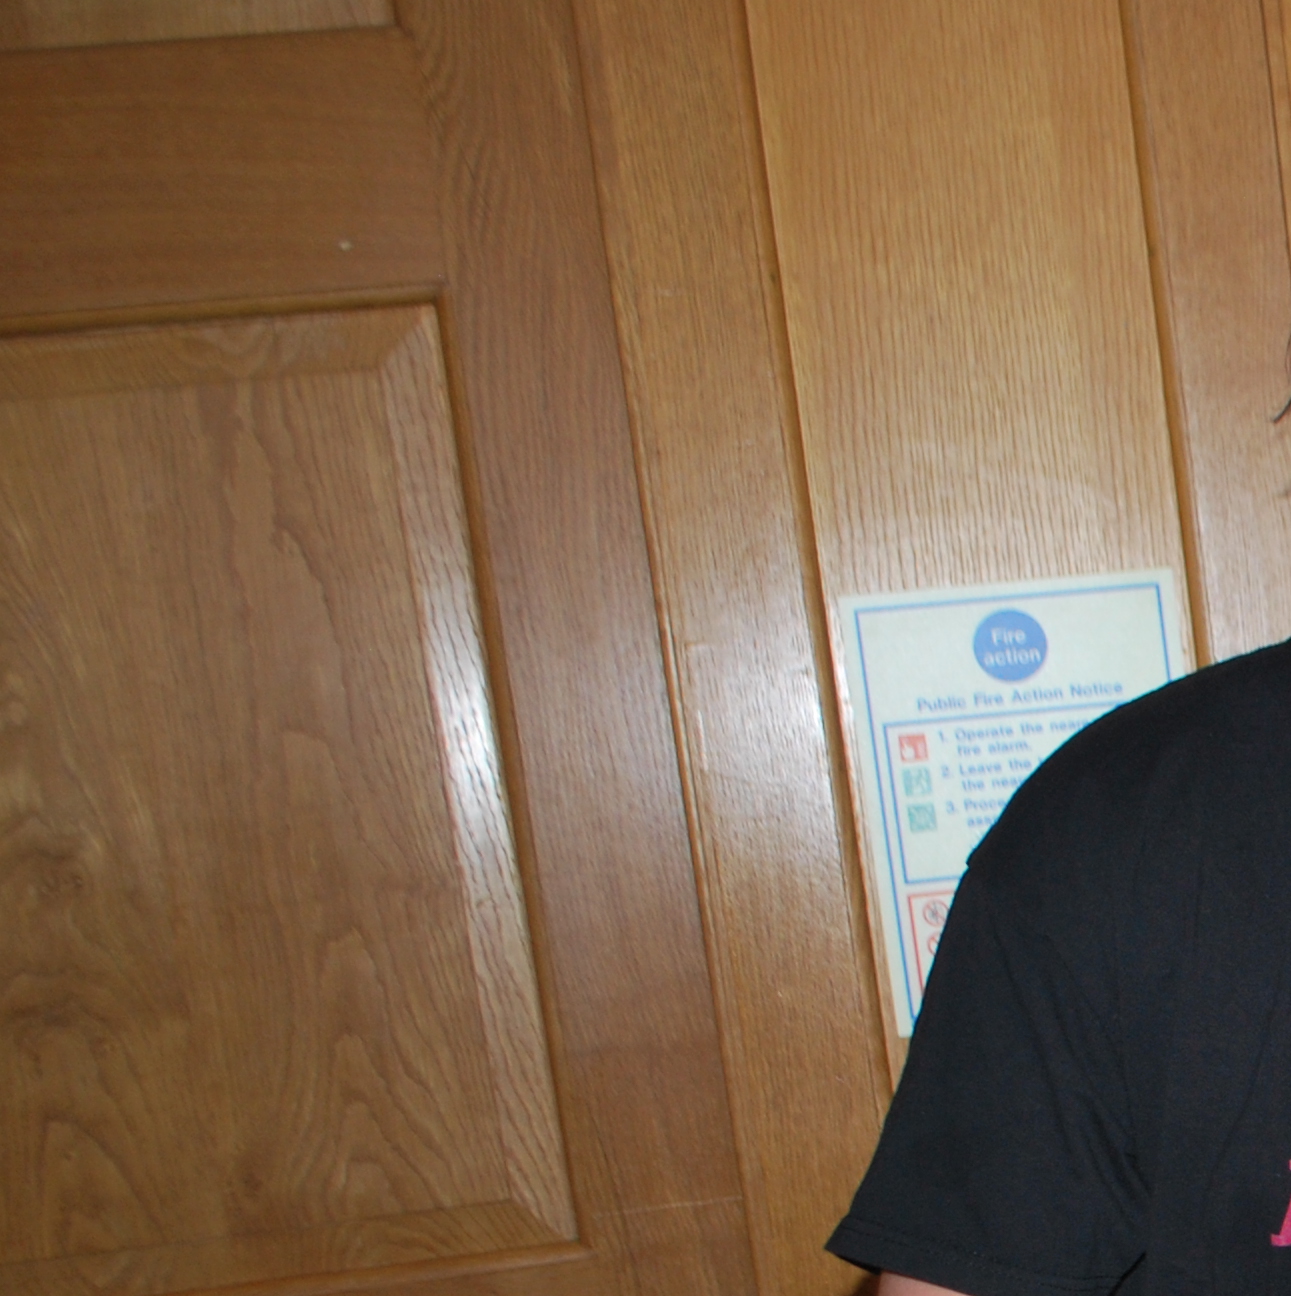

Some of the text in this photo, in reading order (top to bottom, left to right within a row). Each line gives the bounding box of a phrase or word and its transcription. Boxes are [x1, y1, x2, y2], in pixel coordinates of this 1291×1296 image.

[991, 627, 1026, 645] Fire
[983, 648, 1042, 668] action
[917, 681, 1123, 713] Public Fire Action Notice
[955, 726, 1014, 742] Operate
[1020, 722, 1043, 735] the
[959, 762, 1002, 775] Leave
[1008, 757, 1032, 770] the
[962, 779, 985, 792] the
